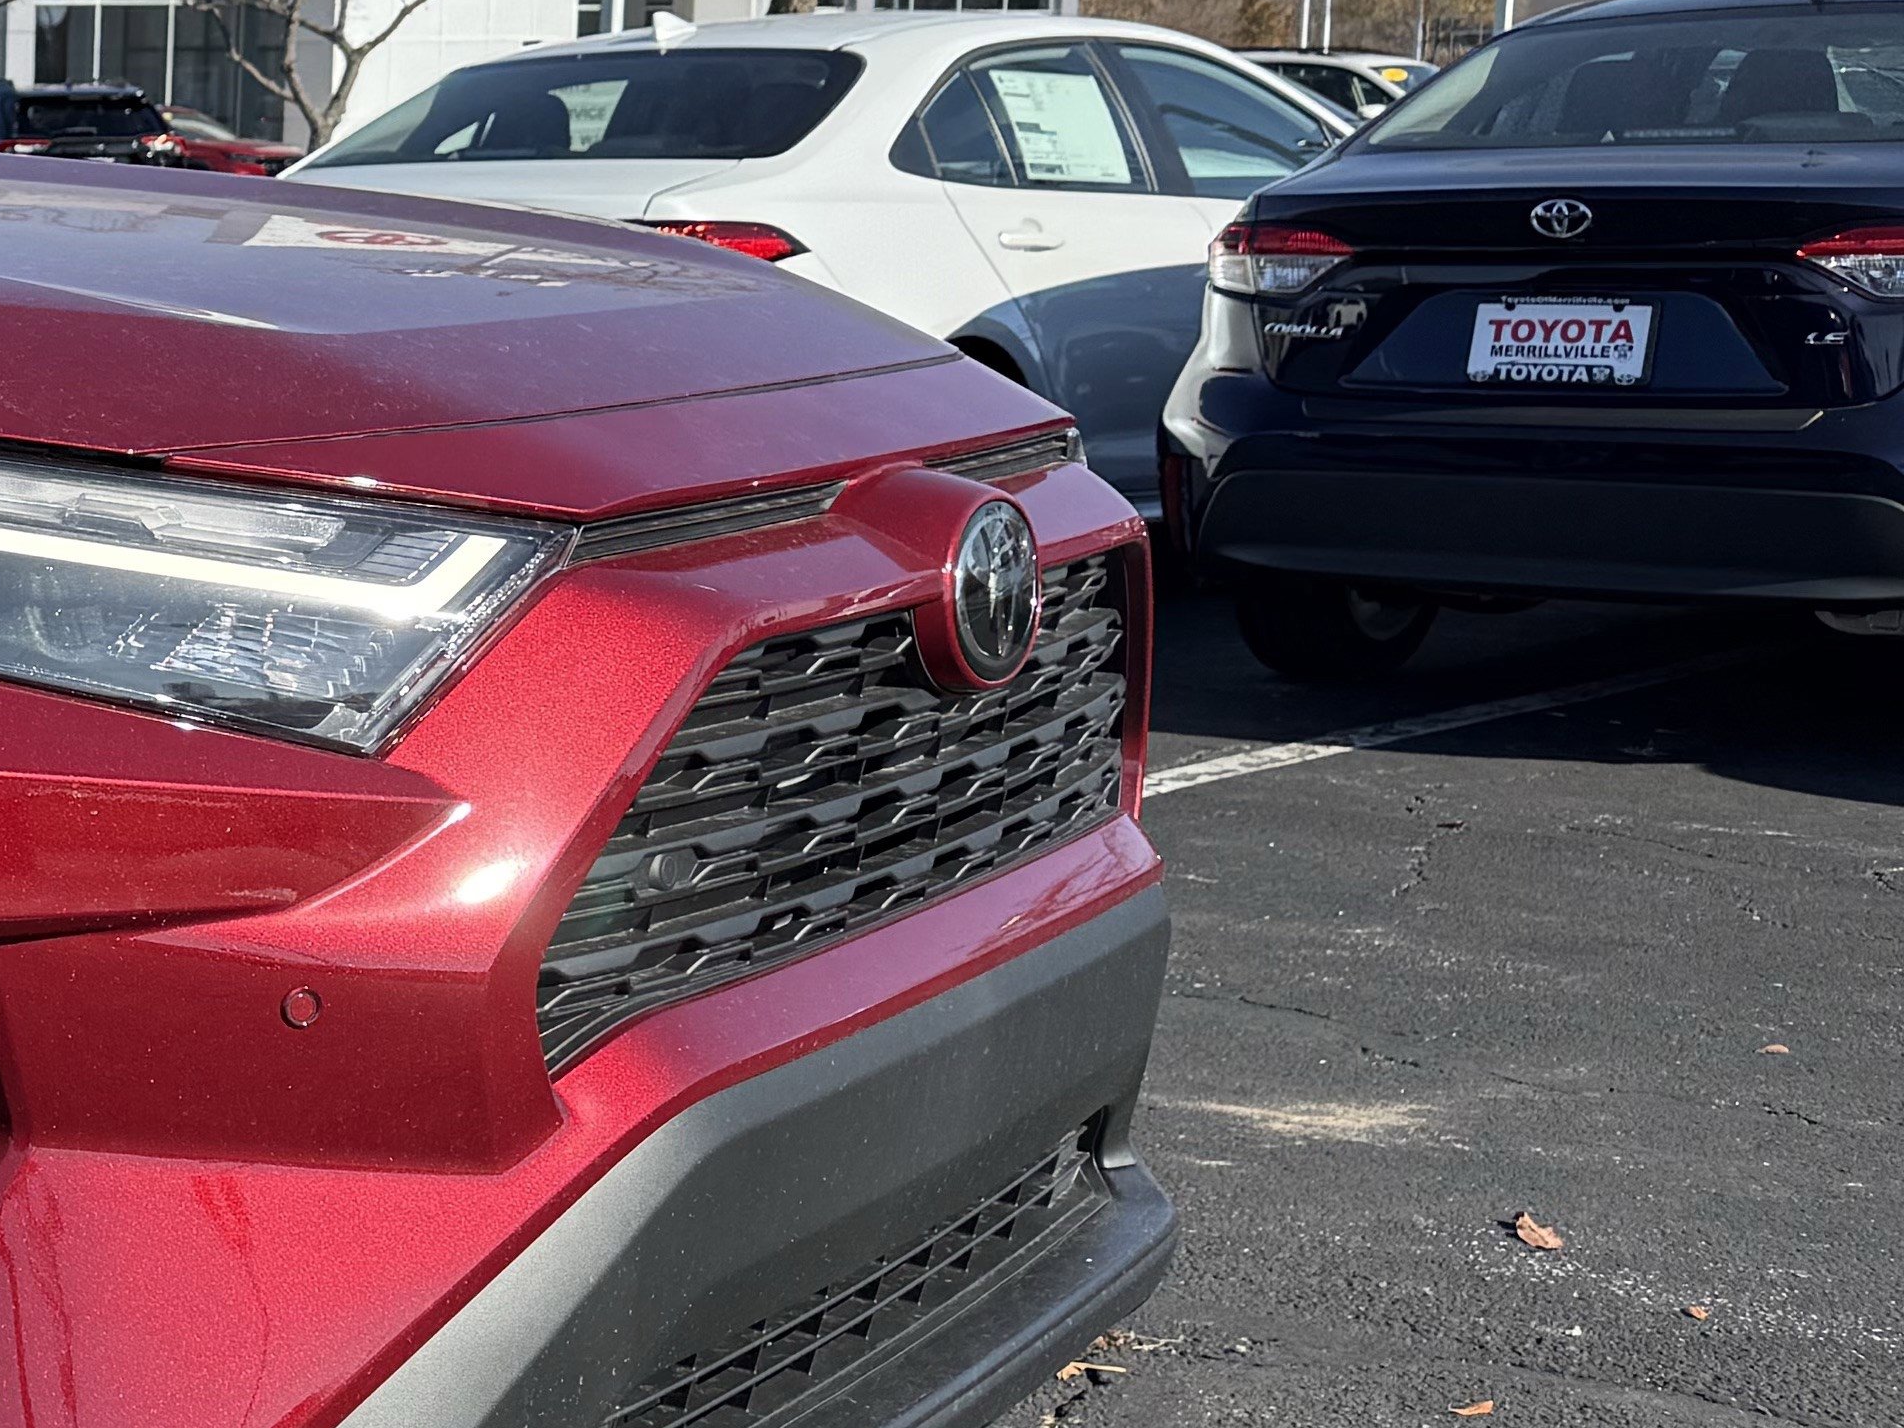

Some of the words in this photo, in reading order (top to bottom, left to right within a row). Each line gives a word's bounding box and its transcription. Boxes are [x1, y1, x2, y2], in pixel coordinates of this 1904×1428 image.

[1489, 319, 1634, 344] TOYOTA
[1490, 344, 1611, 360] MERRILLVILLE
[1496, 363, 1590, 384] TOYOTA
